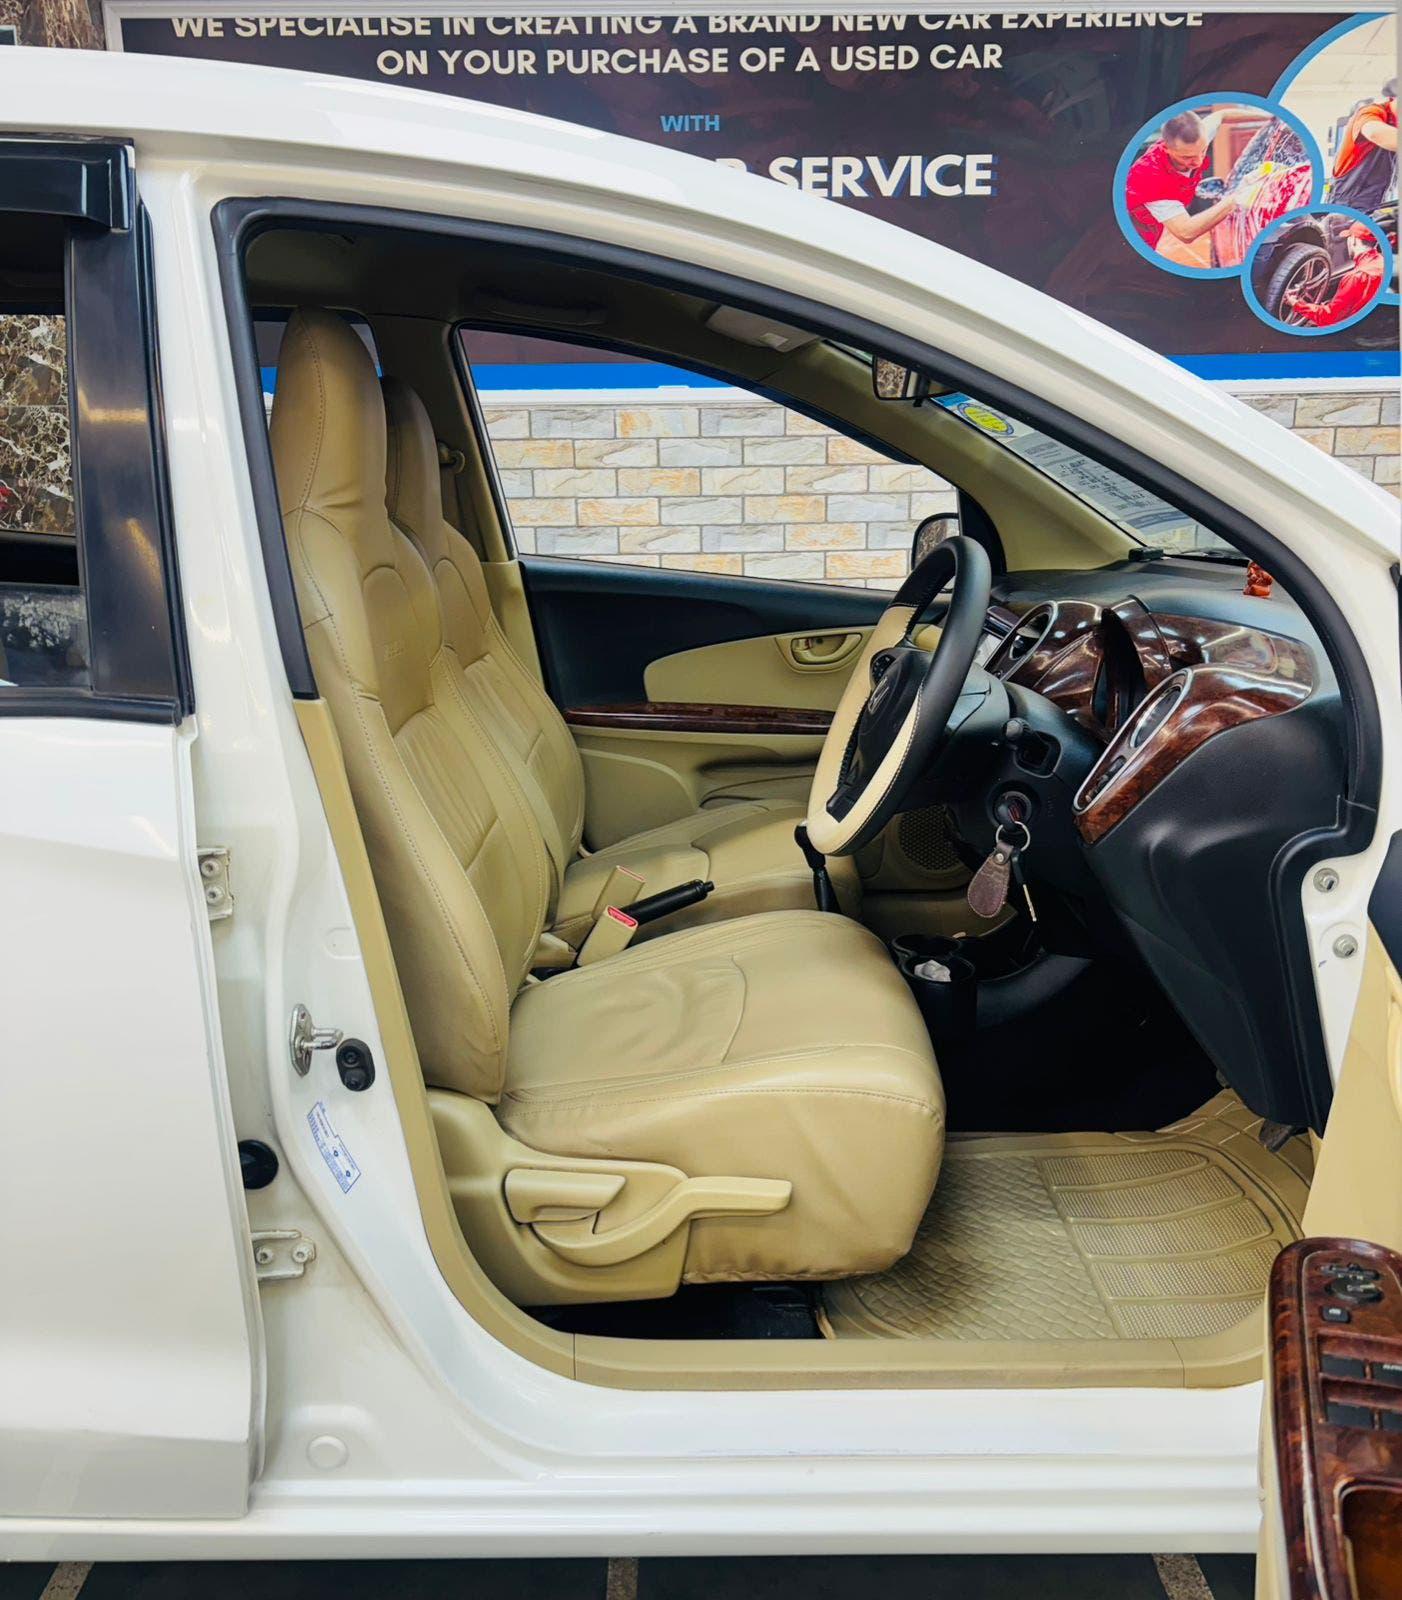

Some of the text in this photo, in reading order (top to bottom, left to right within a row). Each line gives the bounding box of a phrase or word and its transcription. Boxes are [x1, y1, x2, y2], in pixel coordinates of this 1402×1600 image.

[171, 13, 1203, 38] WE SPECIALISE IN CREATING A BRAND NEW CAR EXPERIENCE
[376, 44, 1003, 76] ON YOUR PURCHASE OF A USED CAR
[660, 114, 720, 133] WITH
[768, 153, 994, 198] SERVICE
